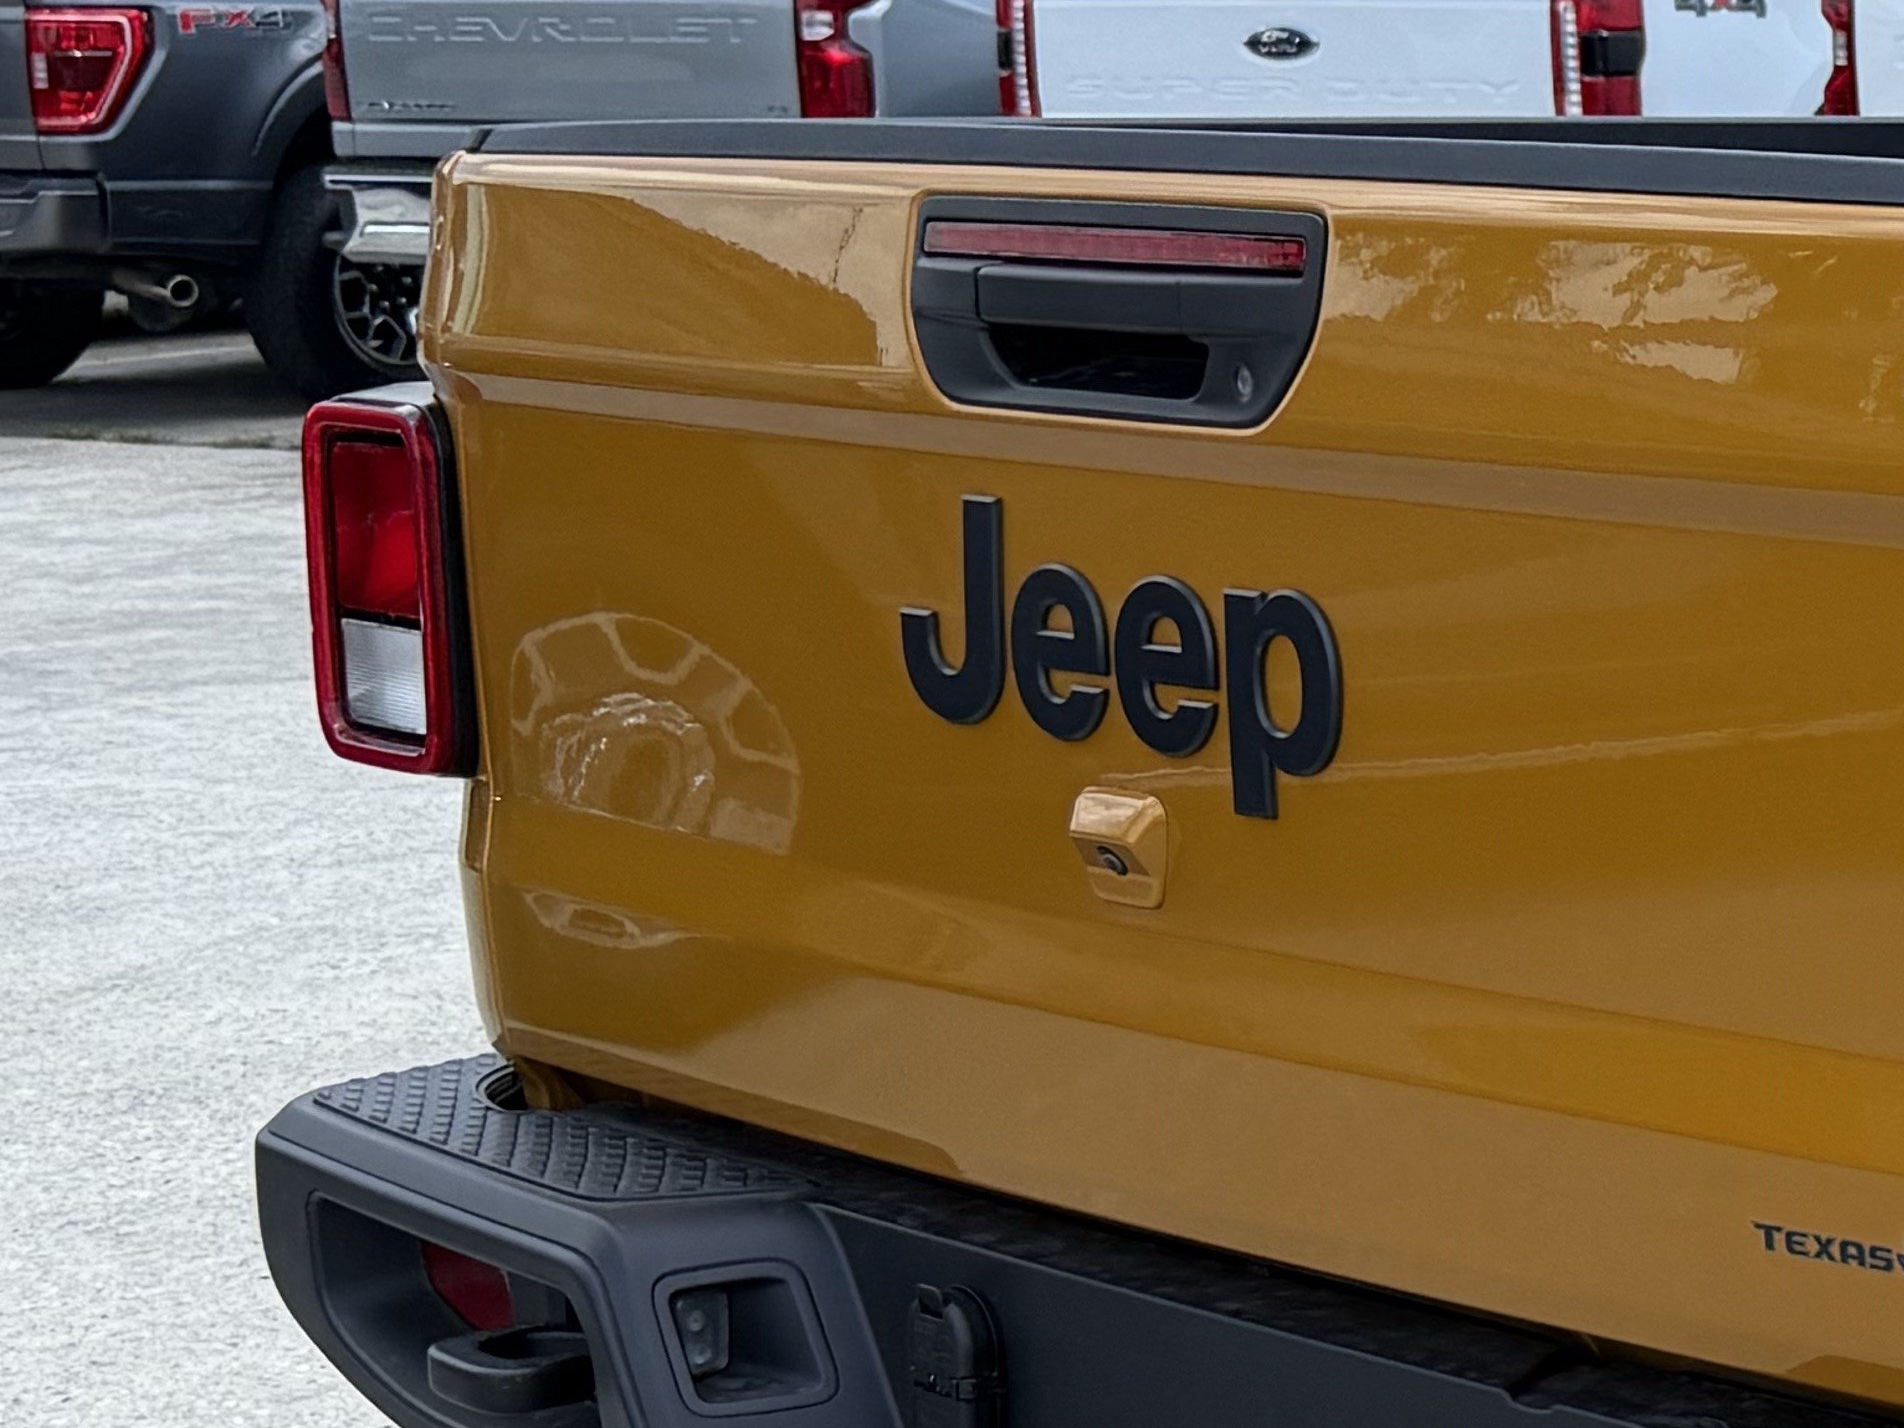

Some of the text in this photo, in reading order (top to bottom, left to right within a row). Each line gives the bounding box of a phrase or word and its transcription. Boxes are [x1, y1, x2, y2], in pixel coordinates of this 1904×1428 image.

[368, 16, 758, 44] CHEVROLET
[1064, 77, 1521, 104] SUPER DUTY
[900, 494, 1342, 820] Jeep
[1752, 1222, 1895, 1273] TEXAS
